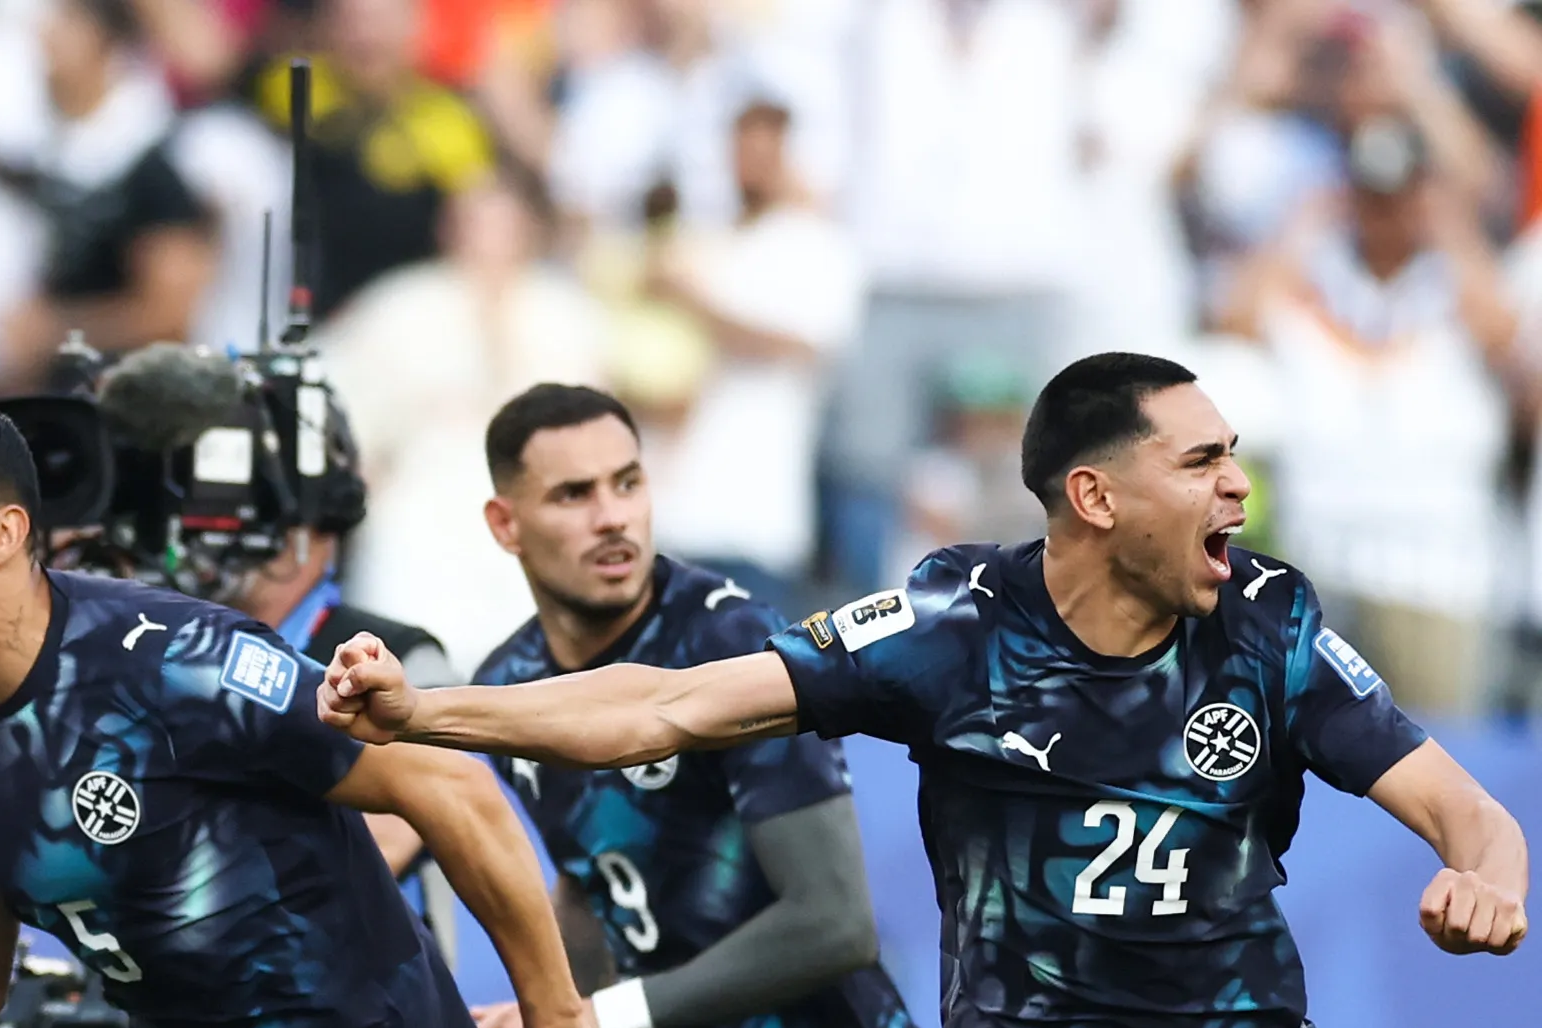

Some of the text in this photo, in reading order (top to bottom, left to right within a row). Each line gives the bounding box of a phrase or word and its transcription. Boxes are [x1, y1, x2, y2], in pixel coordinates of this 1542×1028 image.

[1204, 708, 1229, 726] APF
[87, 776, 107, 793] APF
[1209, 761, 1245, 777] PARAGUAY
[1071, 800, 1192, 916] 24
[595, 852, 659, 953] 9
[56, 898, 143, 984] 5
